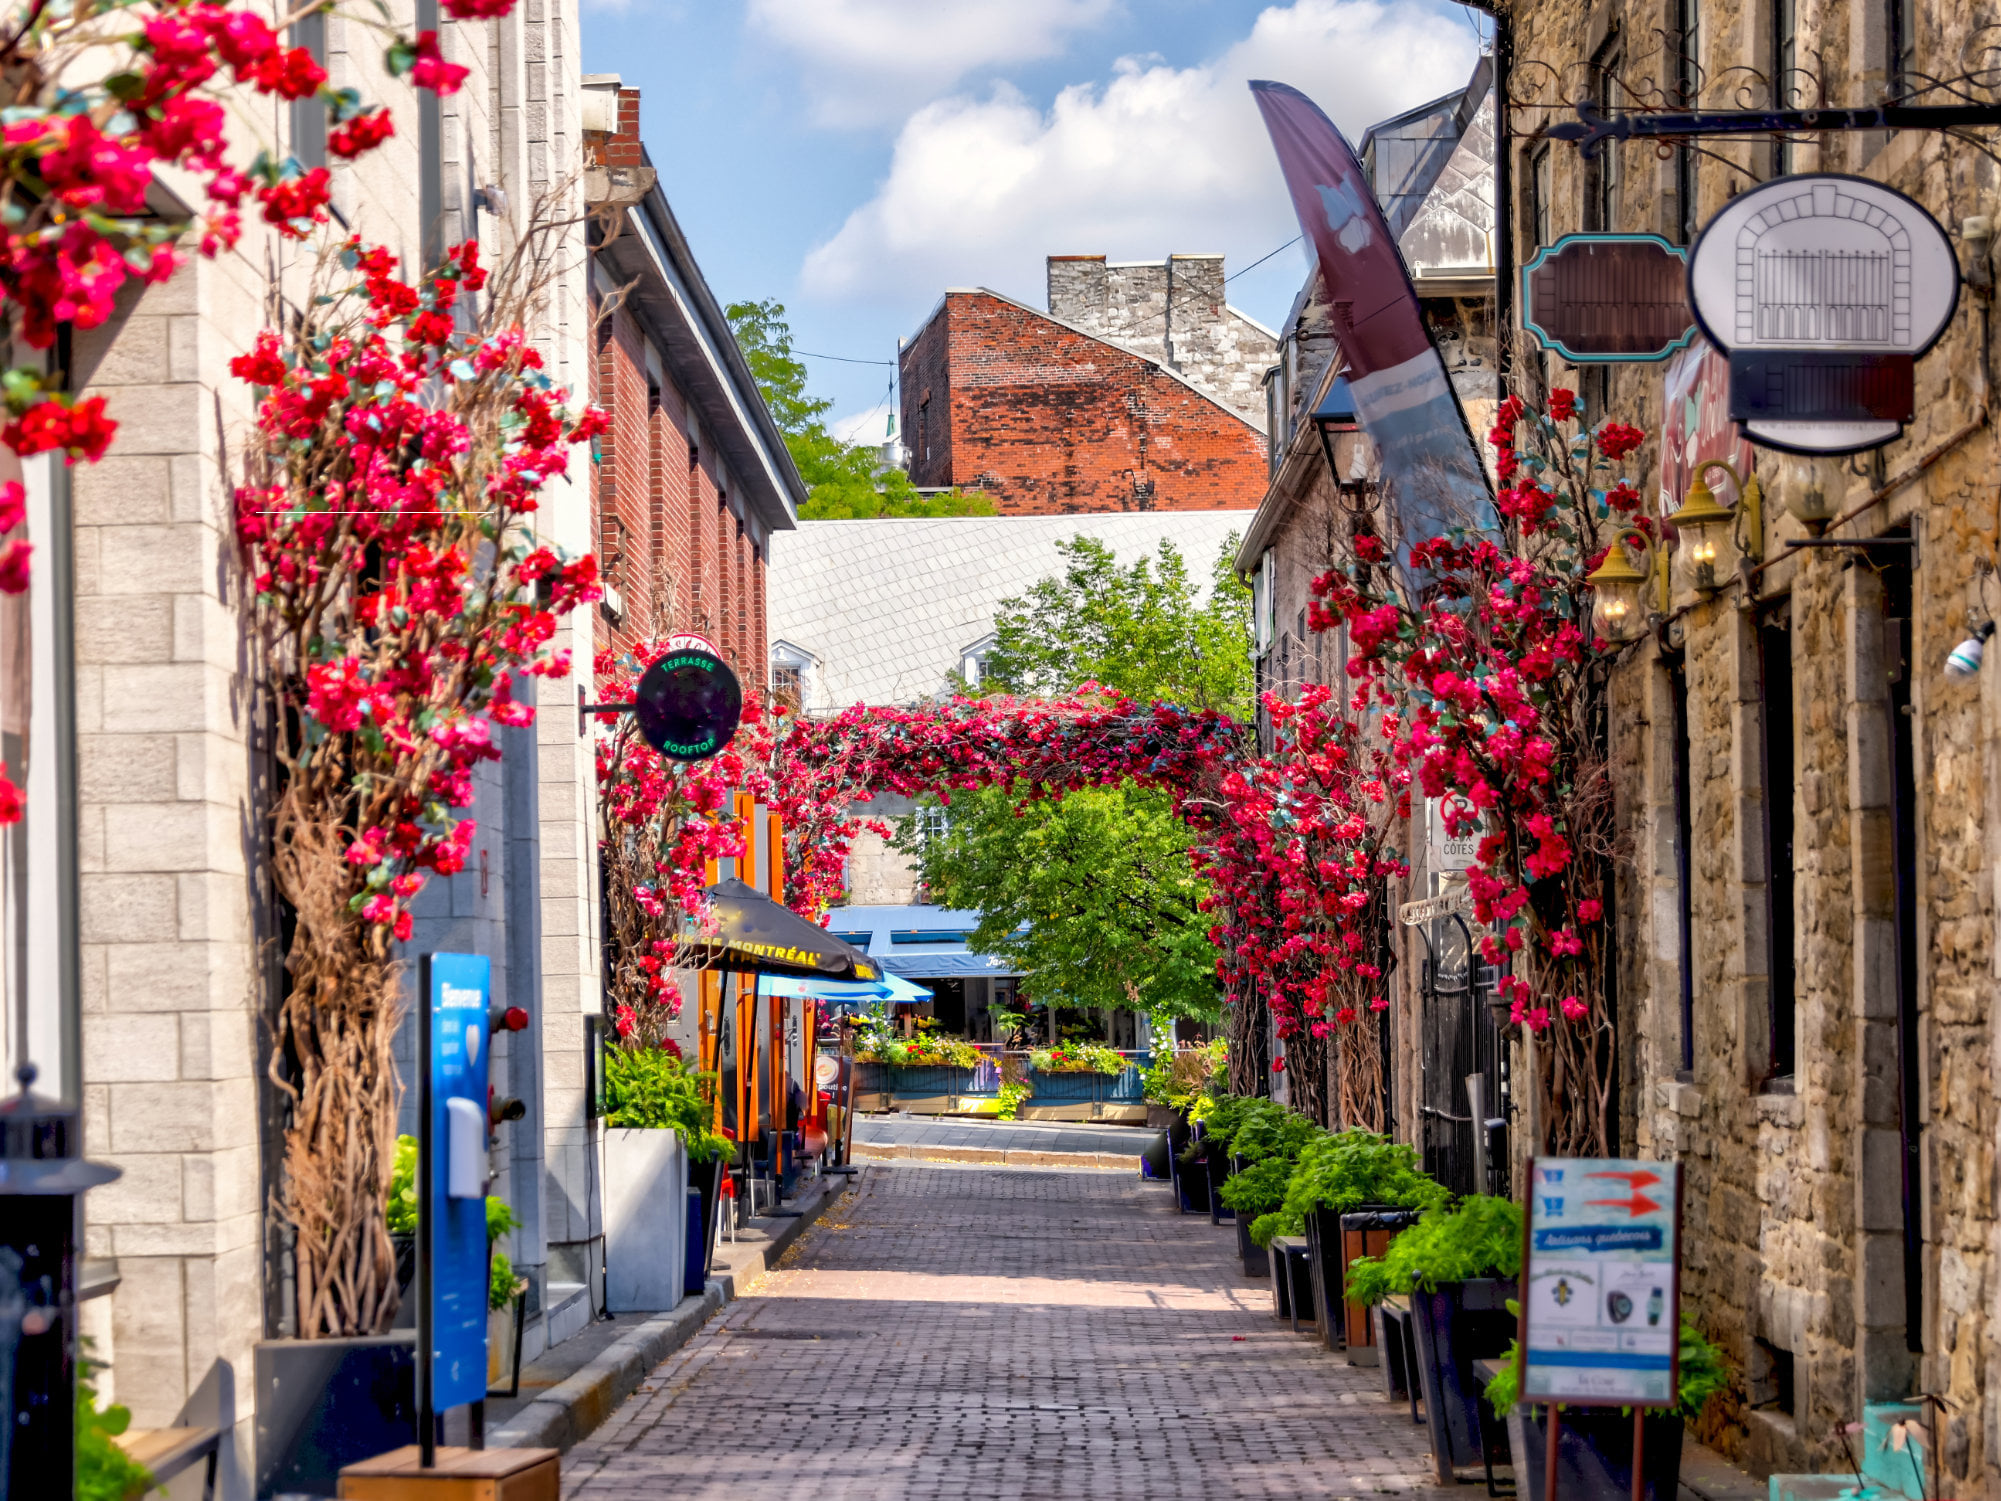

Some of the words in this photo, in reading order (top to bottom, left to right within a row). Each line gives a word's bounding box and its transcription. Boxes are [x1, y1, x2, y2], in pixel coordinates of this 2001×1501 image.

[661, 656, 715, 672] TERRASSE
[663, 737, 714, 754] ROOFTOP
[1443, 842, 1475, 855] CÔTES
[817, 1083, 848, 1091] poutie
